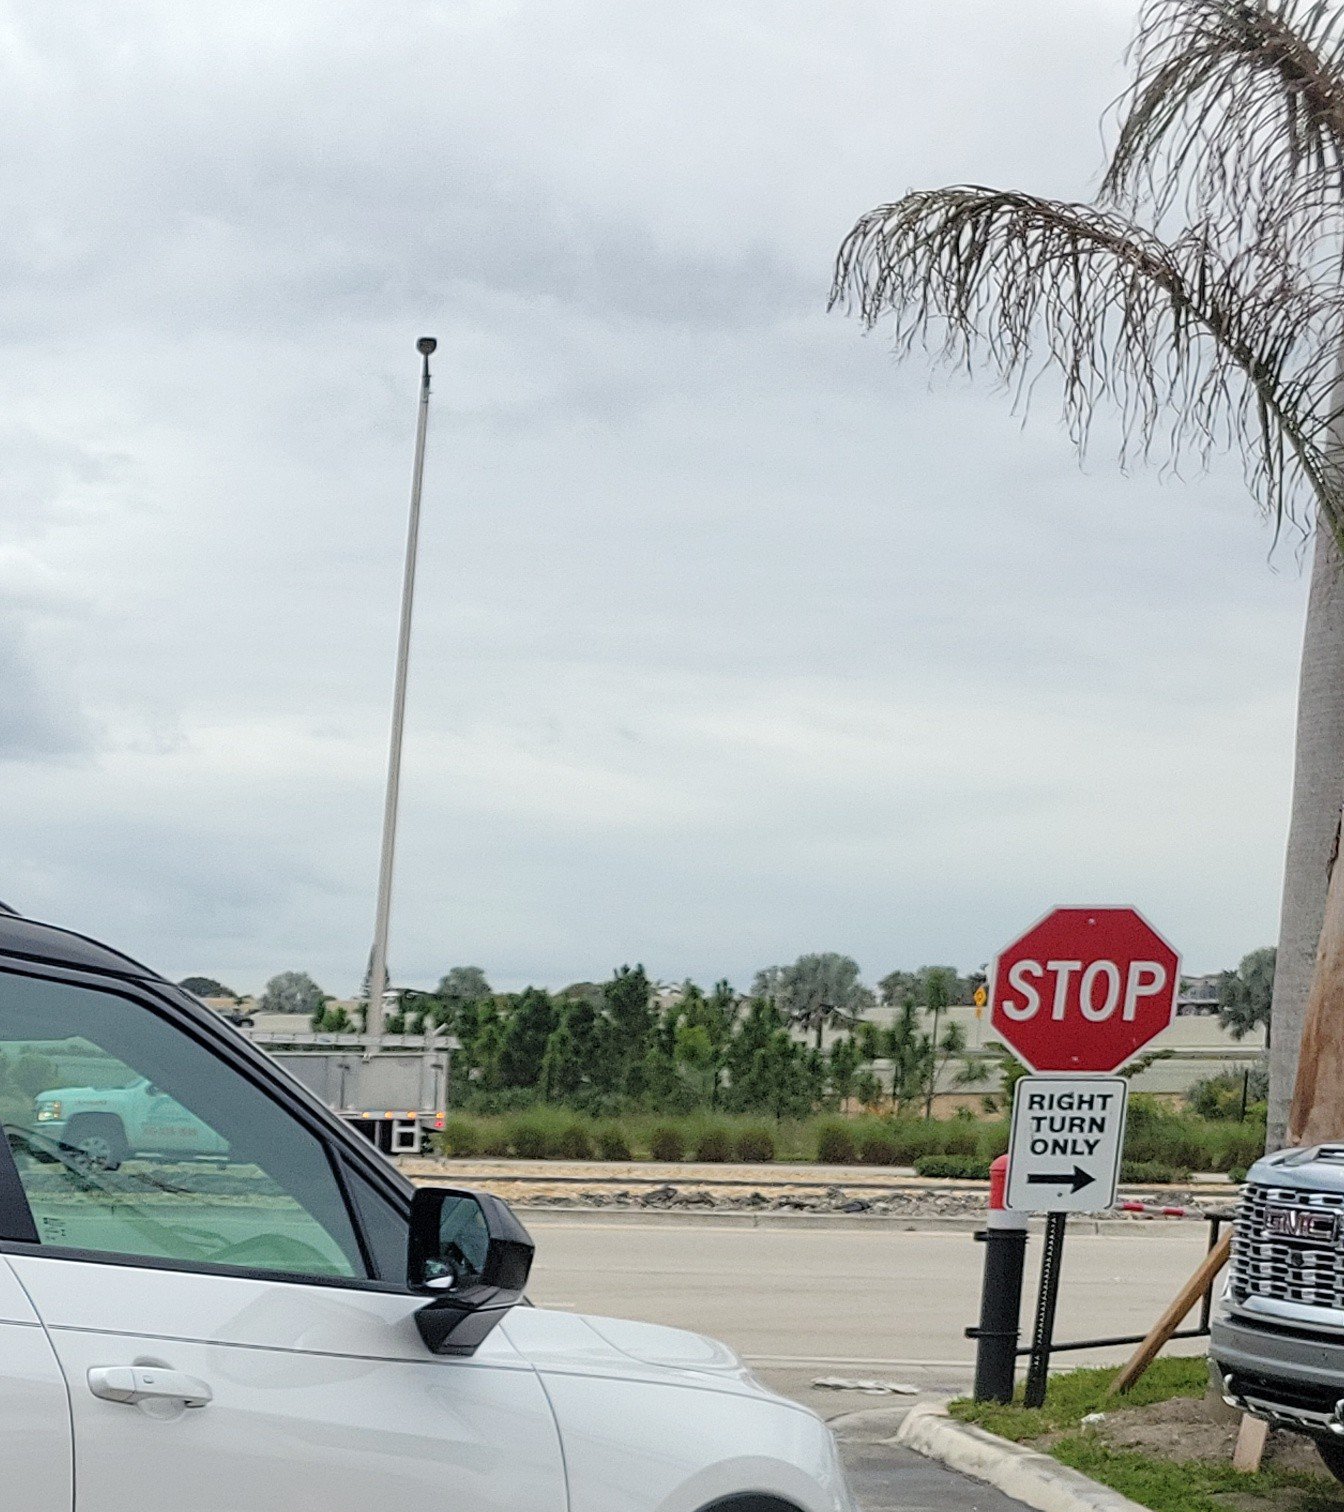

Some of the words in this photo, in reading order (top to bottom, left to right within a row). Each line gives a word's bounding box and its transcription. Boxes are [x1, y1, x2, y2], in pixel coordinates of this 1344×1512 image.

[1002, 959, 1167, 1022] STOP
[1028, 1093, 1113, 1111] RIGHT
[1031, 1116, 1106, 1133] TURN
[1030, 1138, 1101, 1156] ONLY
[1266, 1207, 1335, 1240] GMC
